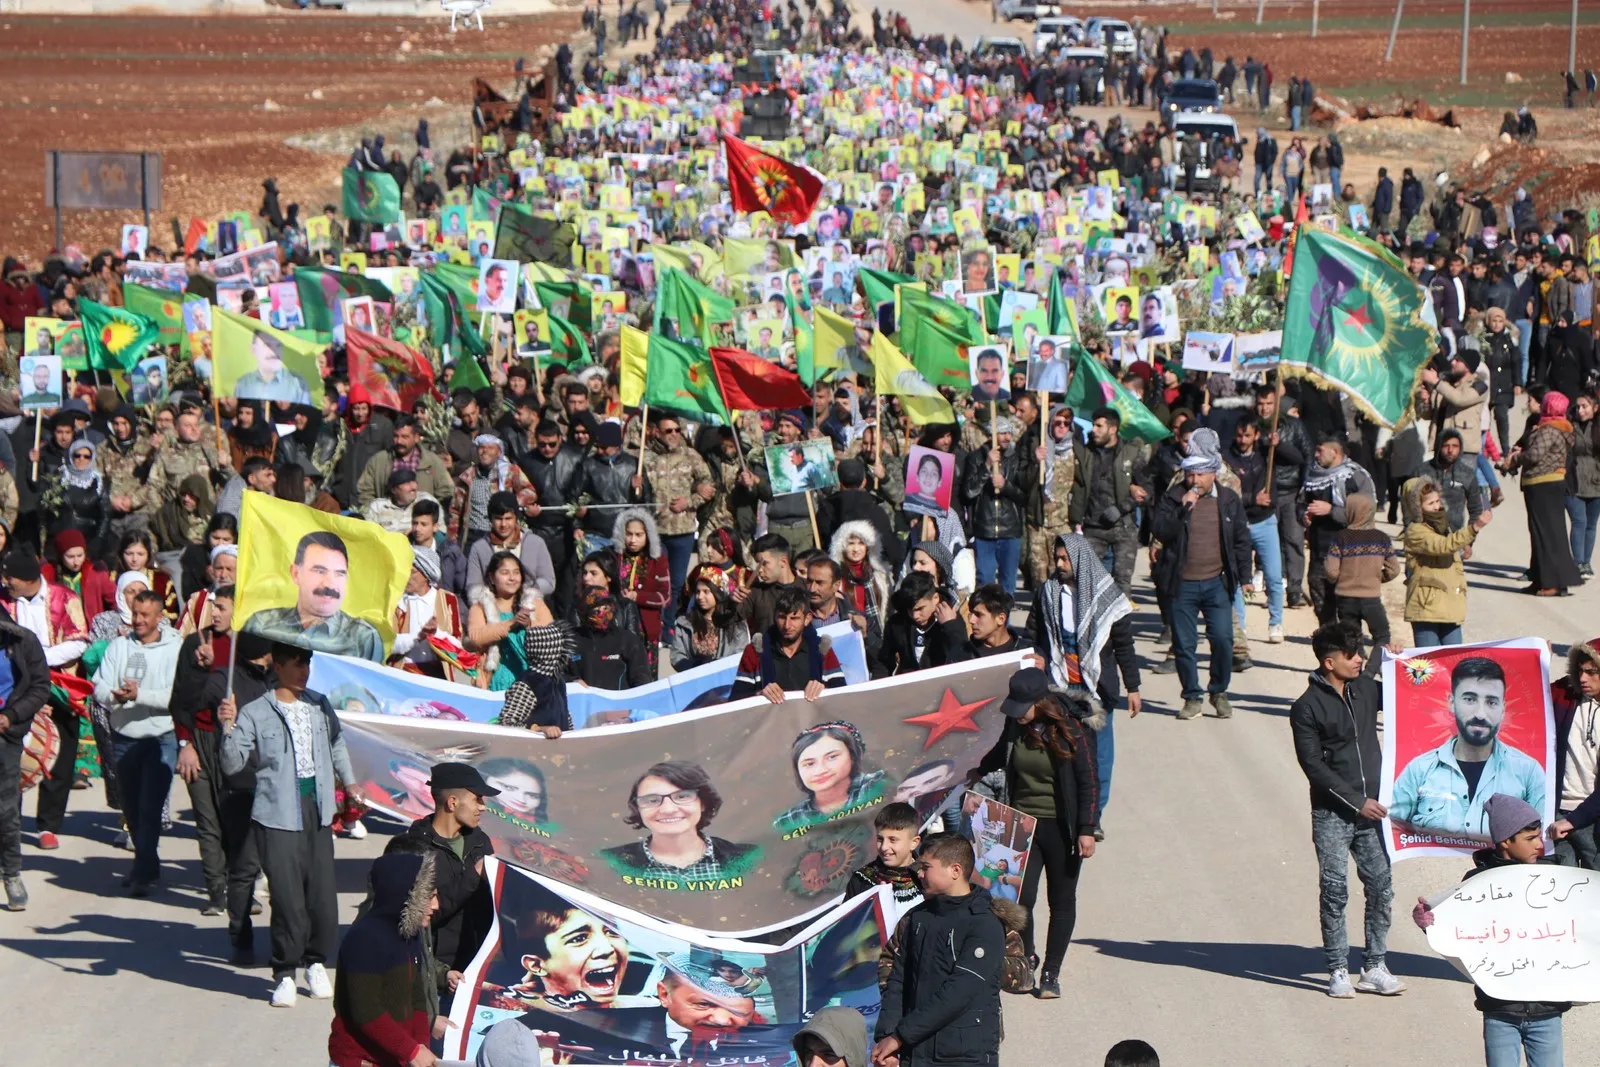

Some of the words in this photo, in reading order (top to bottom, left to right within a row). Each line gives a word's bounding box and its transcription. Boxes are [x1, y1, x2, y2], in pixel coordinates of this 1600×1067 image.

[1400, 833, 1432, 847] Şehid
[1435, 835, 1488, 848] Behdinan
[686, 877, 743, 891] VIYAN
[1525, 873, 1590, 909] بروح
[1454, 883, 1513, 903] مقاومة
